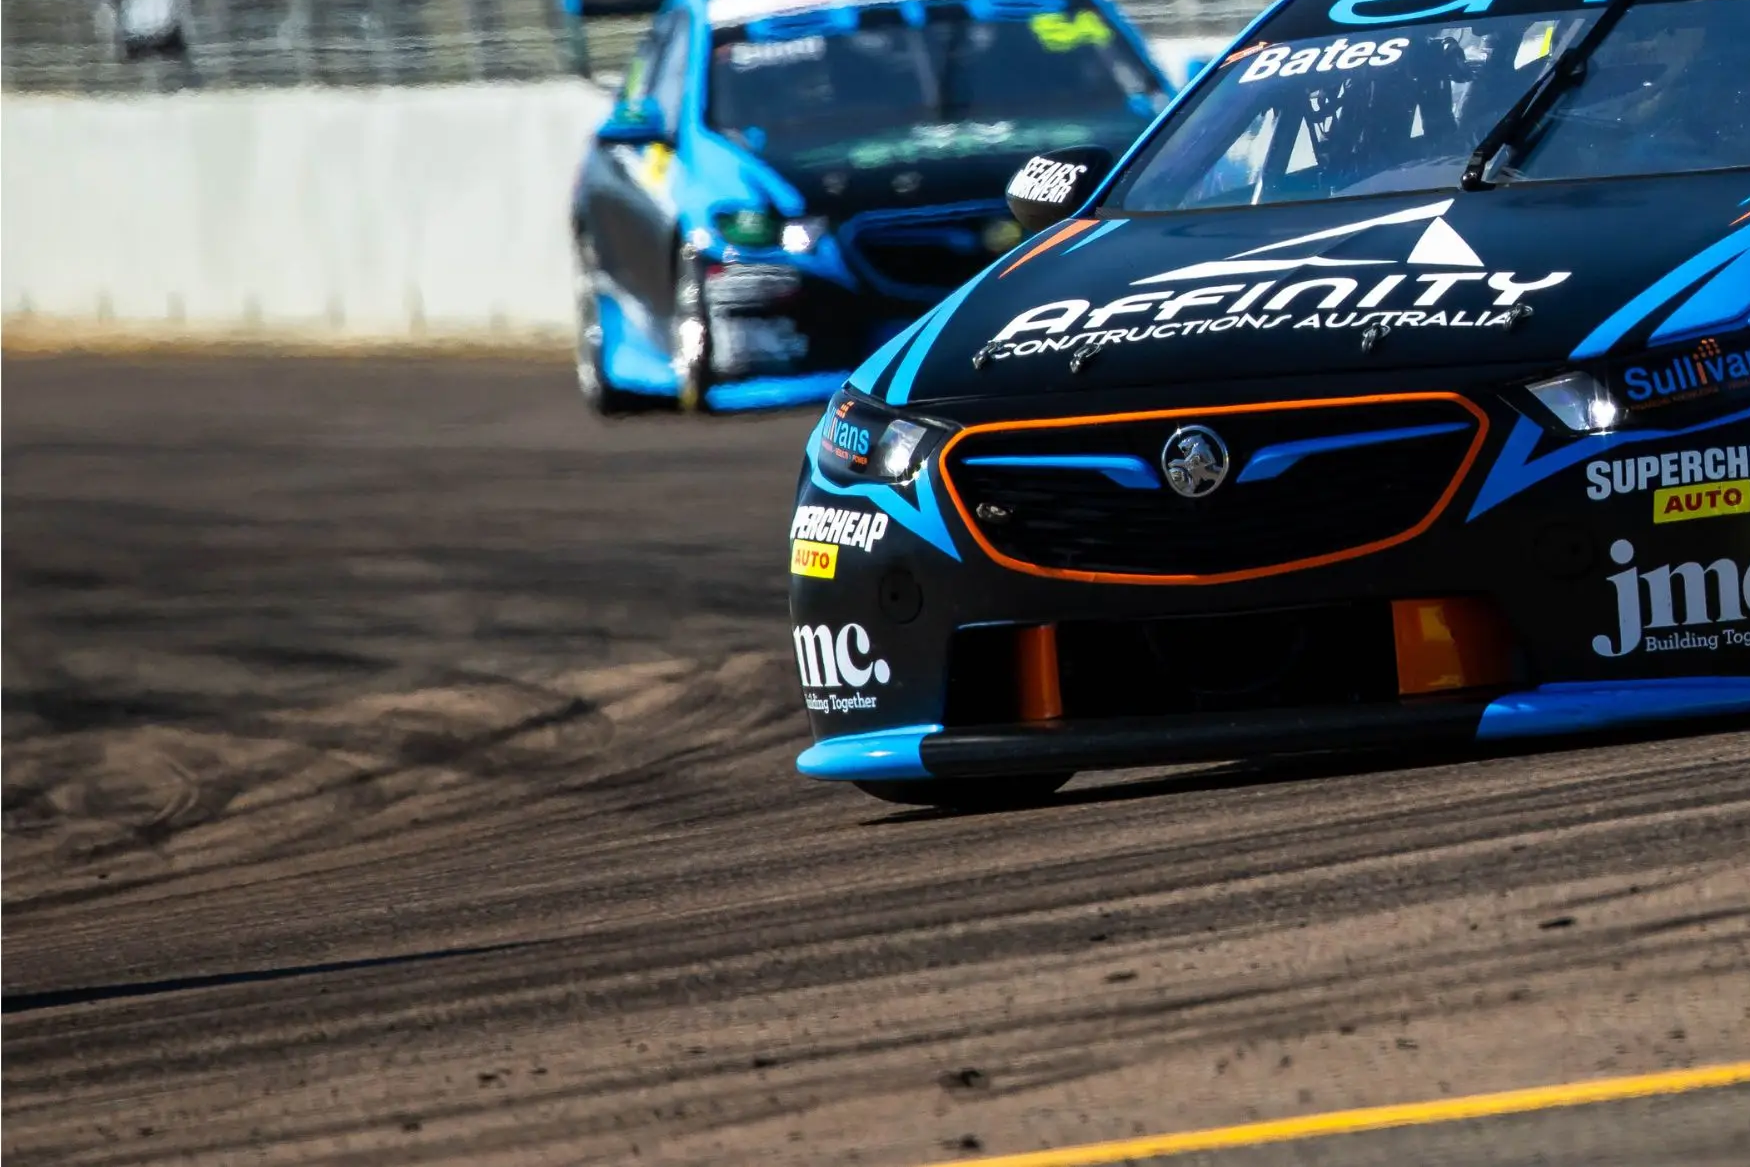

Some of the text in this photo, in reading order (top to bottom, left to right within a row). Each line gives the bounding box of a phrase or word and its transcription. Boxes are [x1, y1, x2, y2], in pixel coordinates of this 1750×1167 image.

[1238, 37, 1410, 84] Bates
[997, 306, 1513, 360] CONSTRUCTIONS AUSTRALIA
[1663, 487, 1743, 514] AUTO
[790, 505, 889, 553] PERCHEAP
[794, 549, 831, 570] AUTO
[792, 622, 891, 688] mc.
[1645, 631, 1719, 652] Building
[829, 691, 877, 714] Together
